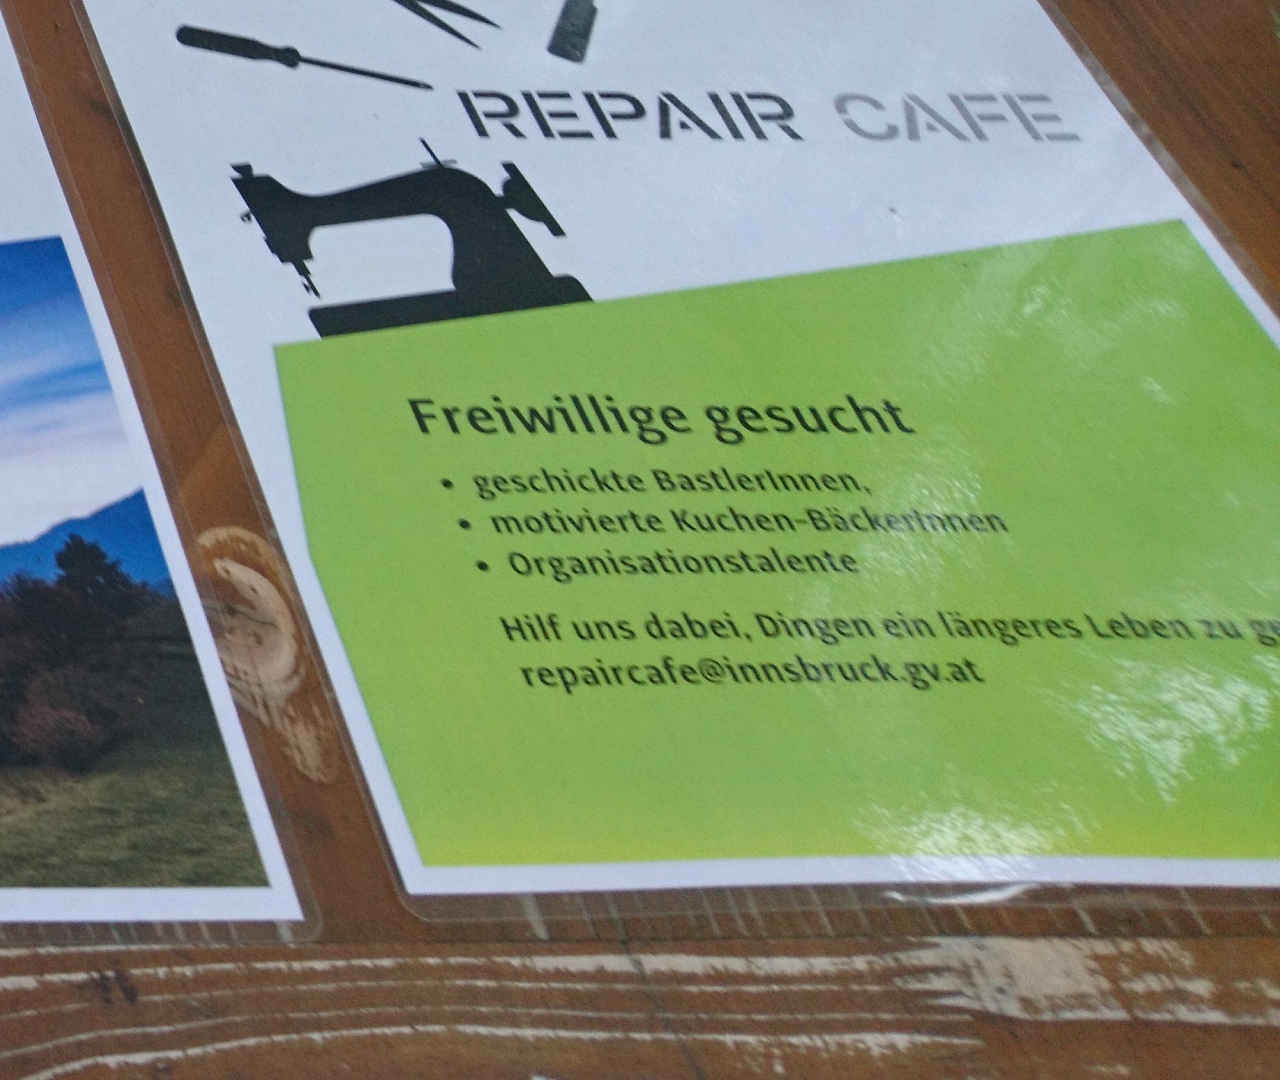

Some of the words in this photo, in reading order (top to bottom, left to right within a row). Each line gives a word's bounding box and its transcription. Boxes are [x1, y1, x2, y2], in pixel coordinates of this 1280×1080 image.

[455, 89, 804, 142] REPAIR
[832, 91, 1082, 143] CAFE
[406, 393, 689, 446] Freiwillige
[704, 394, 917, 446] gesucht
[473, 467, 647, 501] geschickte
[652, 468, 872, 497] BastlerInnen,
[490, 507, 667, 537] motivierte
[671, 507, 1010, 536] Kuchen-BäckerInnen
[507, 549, 860, 582] Organisationstalente
[500, 613, 563, 644] Hilf
[572, 619, 637, 644] uns
[645, 611, 752, 645] dabei,
[755, 612, 877, 648] Dingen
[883, 612, 936, 641] ein
[938, 610, 1083, 646] längeres
[1086, 612, 1191, 640] Leben
[1200, 619, 1245, 640] zu
[520, 656, 986, 697] repaircafe@innsbruck.gv.at
